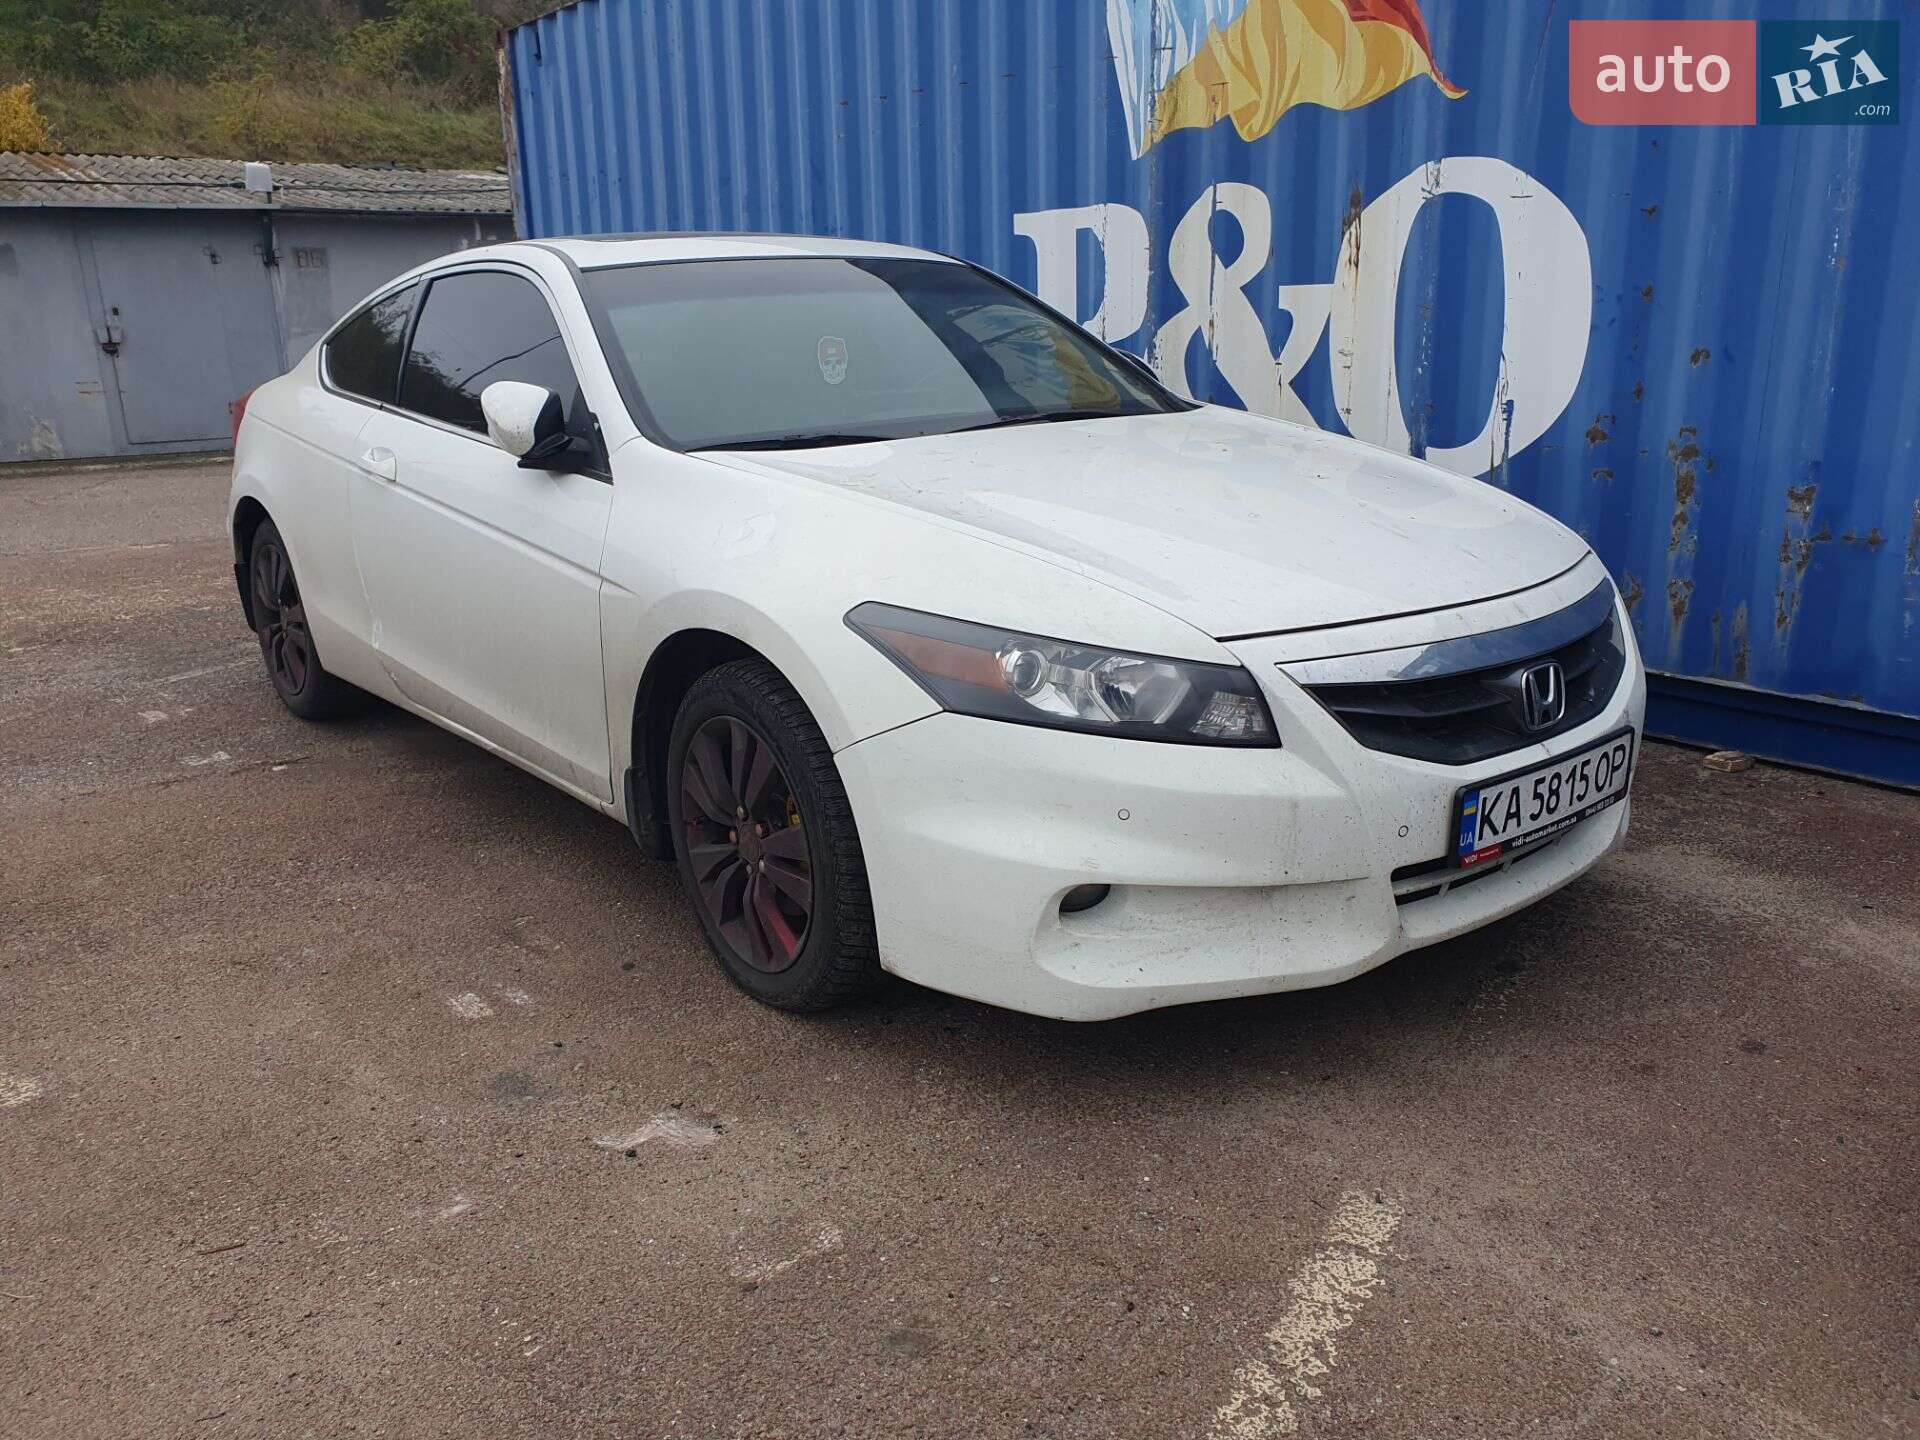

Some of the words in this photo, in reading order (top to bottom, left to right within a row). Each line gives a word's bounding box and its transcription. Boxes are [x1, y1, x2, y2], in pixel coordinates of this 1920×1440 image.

[1477, 785, 1522, 842] KA
[1529, 759, 1592, 821] 5815
[1594, 743, 1627, 793] OP
[1460, 831, 1475, 847] UA
